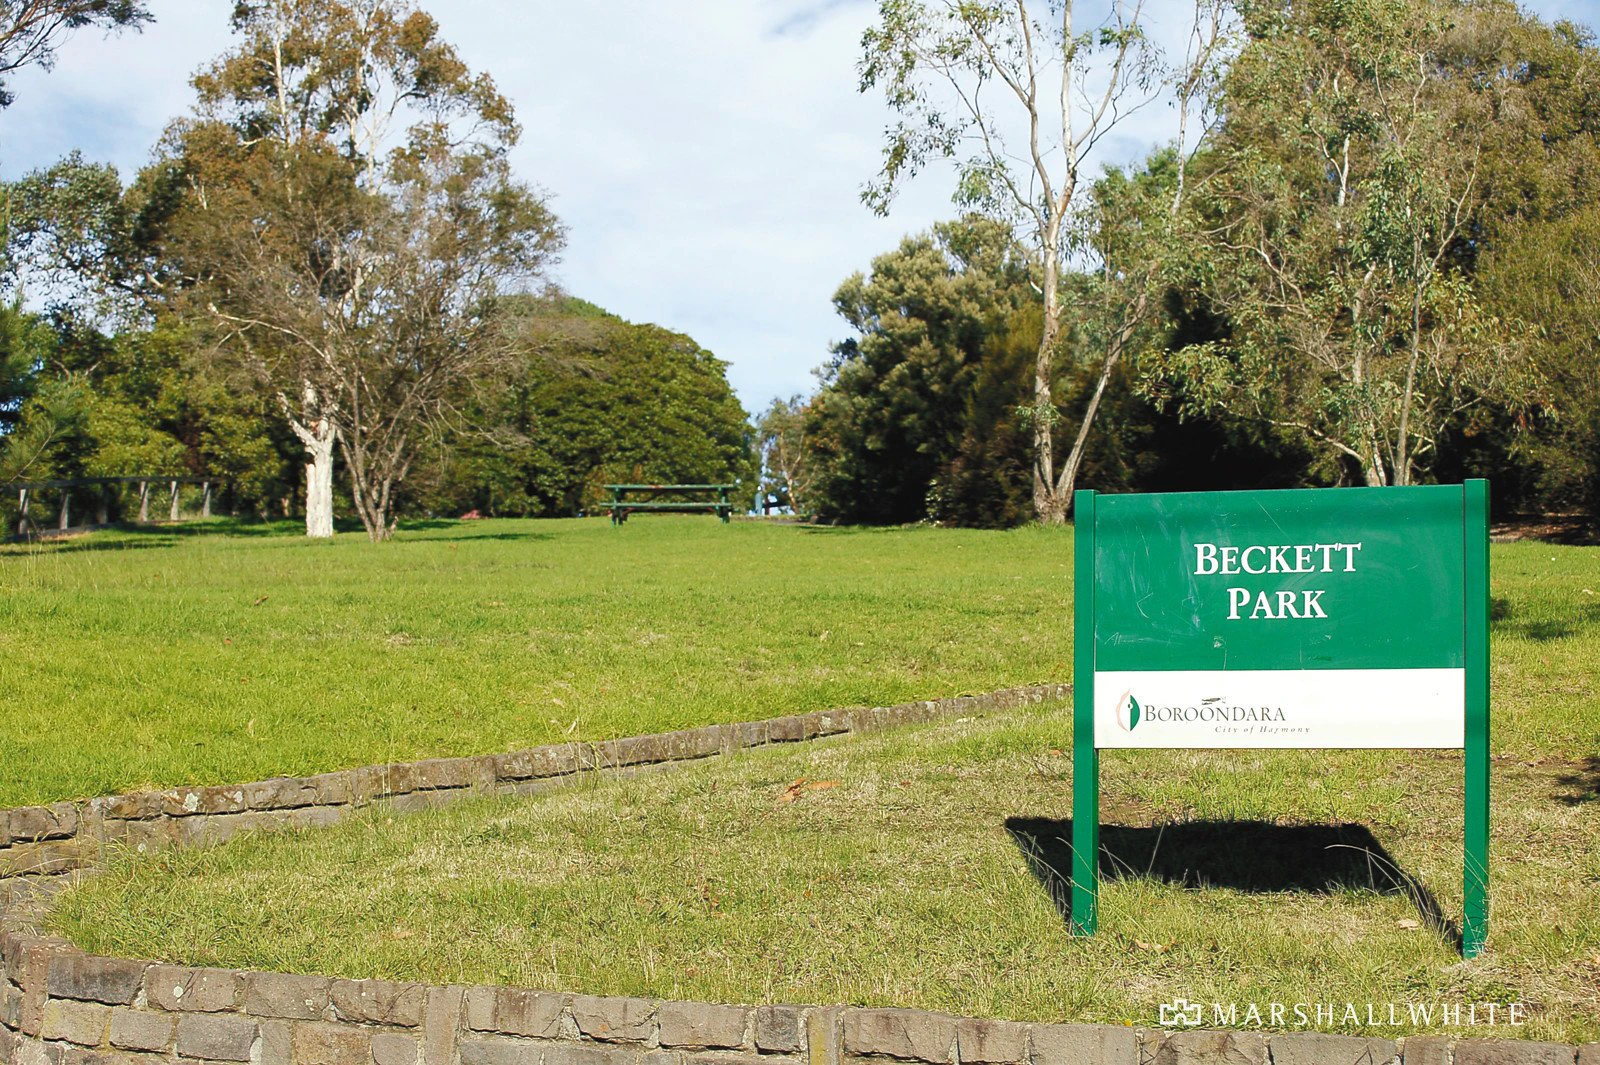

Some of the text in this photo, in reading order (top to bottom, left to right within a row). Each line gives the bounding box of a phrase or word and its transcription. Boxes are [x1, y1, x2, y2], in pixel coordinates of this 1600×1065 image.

[1194, 542, 1362, 575] BECKETT
[1226, 587, 1328, 620] PARK
[1144, 704, 1287, 722] BOROONDARA
[1214, 725, 1238, 734] City
[1243, 725, 1255, 734] of
